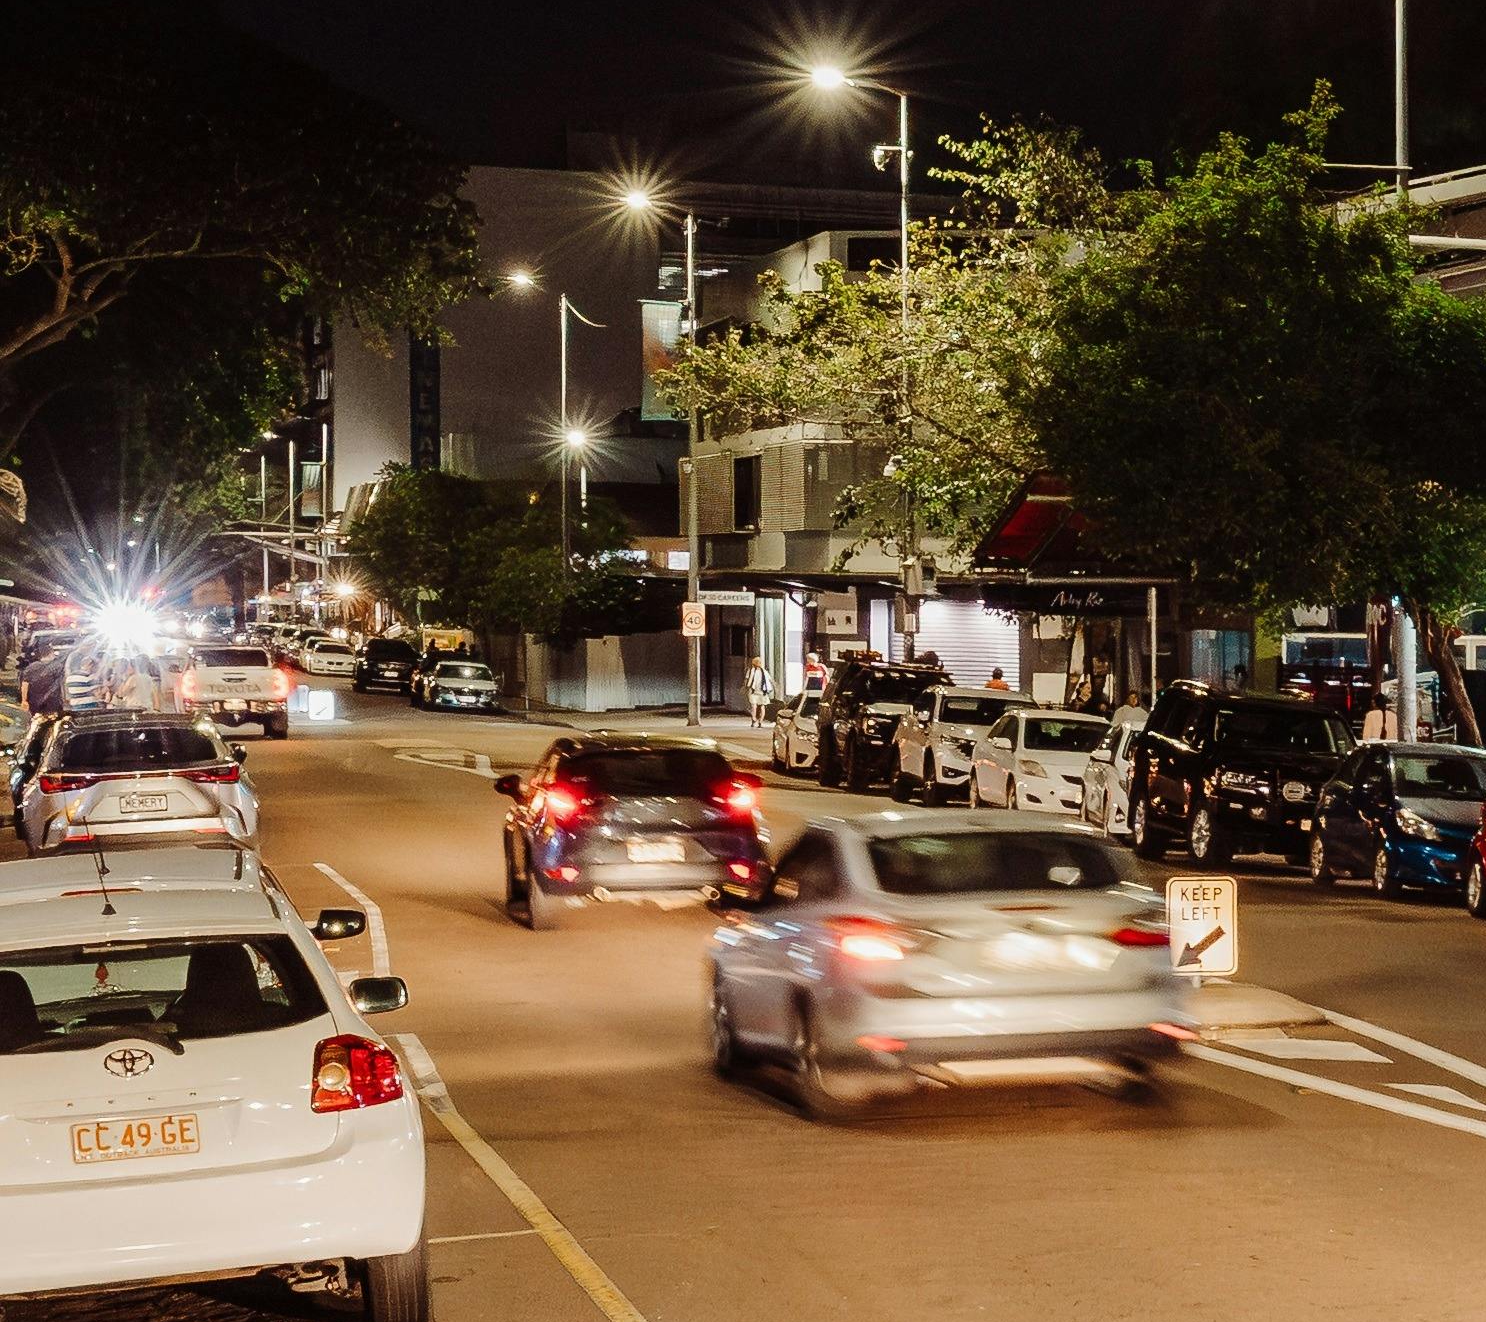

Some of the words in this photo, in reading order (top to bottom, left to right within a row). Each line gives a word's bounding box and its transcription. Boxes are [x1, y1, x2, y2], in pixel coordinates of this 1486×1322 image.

[687, 616, 701, 625] 40
[208, 684, 262, 694] TOYOTA
[1181, 887, 1223, 901] KEEP
[1181, 907, 1221, 921] LEFT
